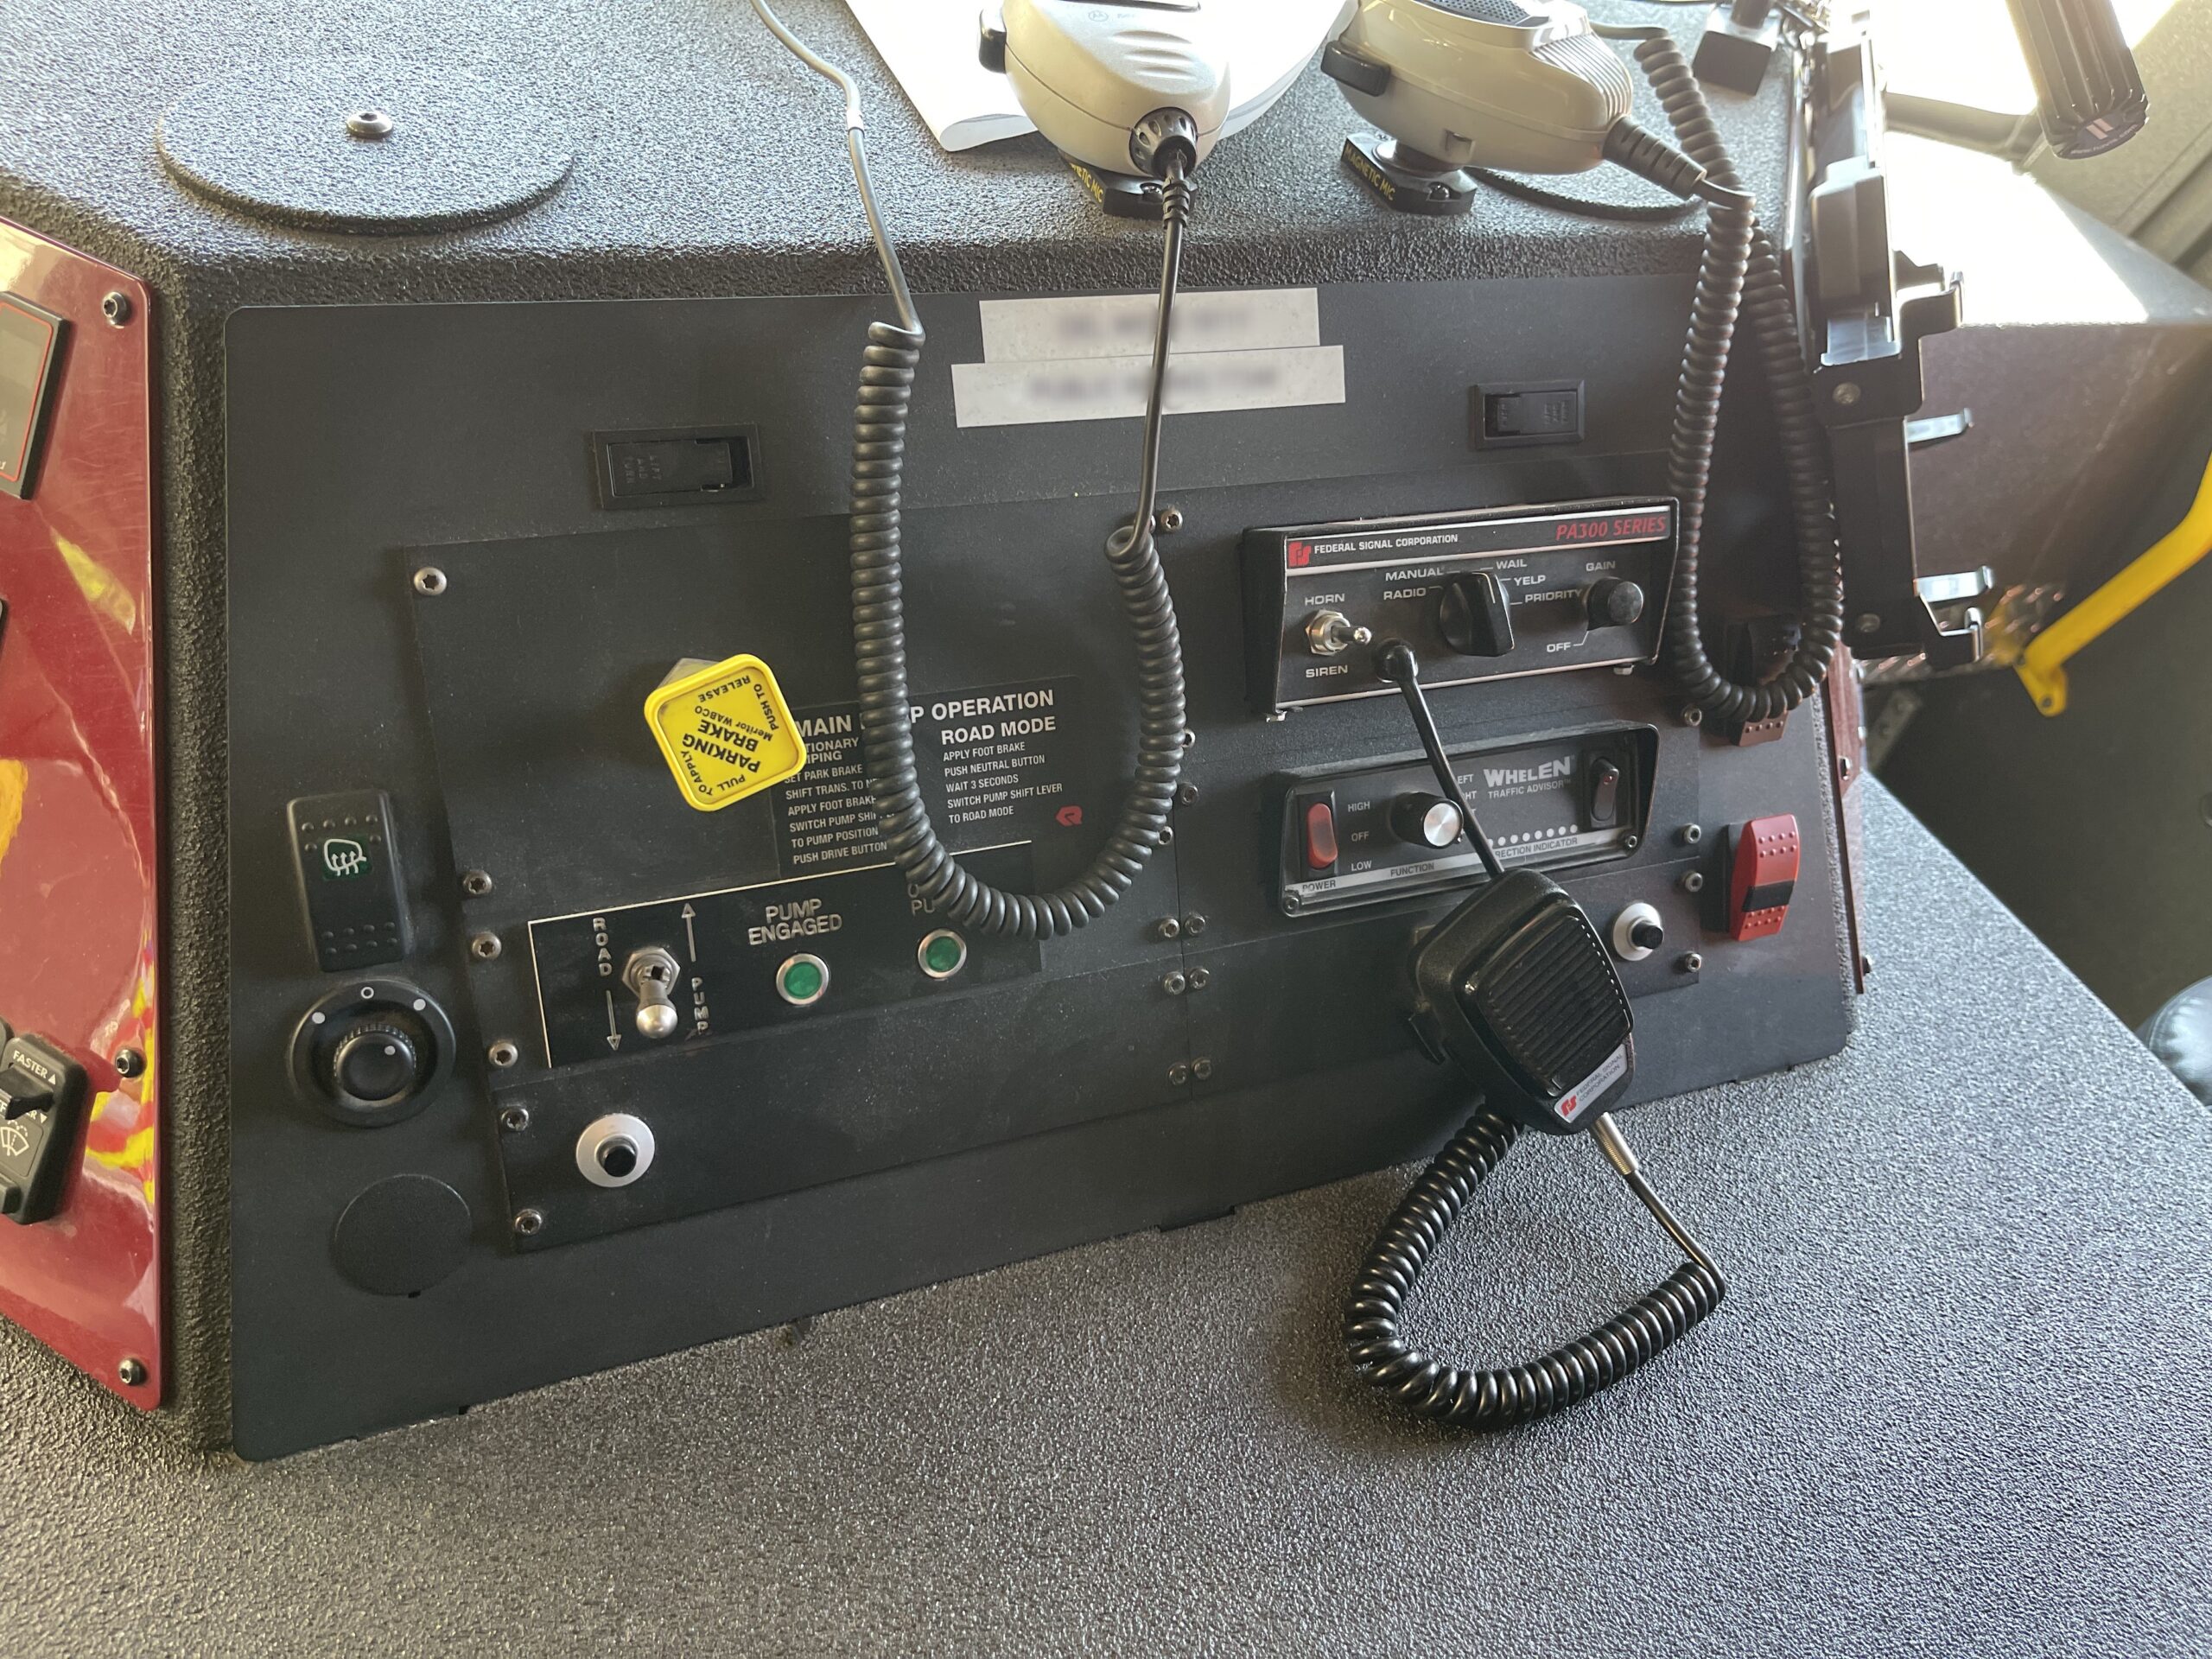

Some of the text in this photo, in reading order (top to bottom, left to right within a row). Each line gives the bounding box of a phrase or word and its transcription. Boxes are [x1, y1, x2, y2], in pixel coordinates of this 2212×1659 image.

[1344, 143, 1395, 200] MAGNETIC MIC
[1090, 179, 1103, 203] MIC
[1555, 516, 1667, 541] PA300 SERIES
[1313, 533, 1459, 555] FEDERAL SIGNAL CORPORATION
[1496, 558, 1528, 570] WAIL
[1586, 561, 1616, 572] GAIN
[1385, 567, 1444, 582] MANUAL
[1514, 575, 1547, 587] YELP
[1305, 593, 1345, 606] HORN
[1383, 587, 1427, 601] RADIO
[1524, 588, 1583, 603] PRIORITY
[1547, 642, 1571, 653] OFF
[1306, 664, 1348, 678] SIREN
[698, 675, 751, 702] RELEASE
[753, 683, 779, 731] PUSH TO
[795, 715, 852, 737] MAIN
[931, 690, 1054, 721] OPERATION
[695, 705, 773, 741] Meritor WABCO
[941, 715, 1057, 746] ROAD MODE
[697, 719, 759, 752] BRAKE
[806, 737, 859, 753] TIONARY
[682, 733, 761, 772] PARKING
[807, 750, 842, 765] PING
[943, 741, 1026, 761] APPLY FOOT BRAKE
[681, 749, 713, 797] TO APPLY
[804, 768, 830, 781] PARK
[831, 764, 863, 778] BRAKE
[944, 754, 1045, 777] PUSH NEUTRAL BUTTON
[1484, 756, 1571, 787] WHELEN
[717, 774, 746, 791] PULL
[945, 774, 1019, 793] WAIT 3 SECONDS
[1456, 774, 1473, 784] EFT
[785, 787, 812, 800] SHIFT
[816, 783, 850, 796] TRANS.
[851, 779, 864, 791] TO
[947, 783, 1063, 809] SWITCH PUMP SHIFT LEVER
[1488, 787, 1524, 799] TRAFFIC
[788, 803, 817, 817] APPLY
[820, 799, 843, 811] FOOT
[949, 805, 1014, 824] TO ROAD MODE
[1348, 801, 1370, 812] HIGH
[789, 818, 826, 833] SWITCH
[829, 813, 855, 827] PUMP
[791, 827, 879, 849] TO PUMP POSITION
[1351, 831, 1370, 842] OFF
[793, 842, 887, 865] PUSH DRIVE BUTTON
[1495, 837, 1578, 859] RECTION INDICATOR
[1351, 860, 1372, 872] LOW
[1390, 861, 1434, 877] FUNCTION
[1302, 880, 1337, 893] POWER
[766, 898, 822, 924] PUMP
[912, 898, 935, 916] PU
[747, 913, 842, 945] ENGAGED
[593, 917, 613, 976] ROAD
[691, 976, 709, 1035] PUMP
[13, 1051, 48, 1078] FASTER
[1579, 1065, 1620, 1102] CORPORATION
